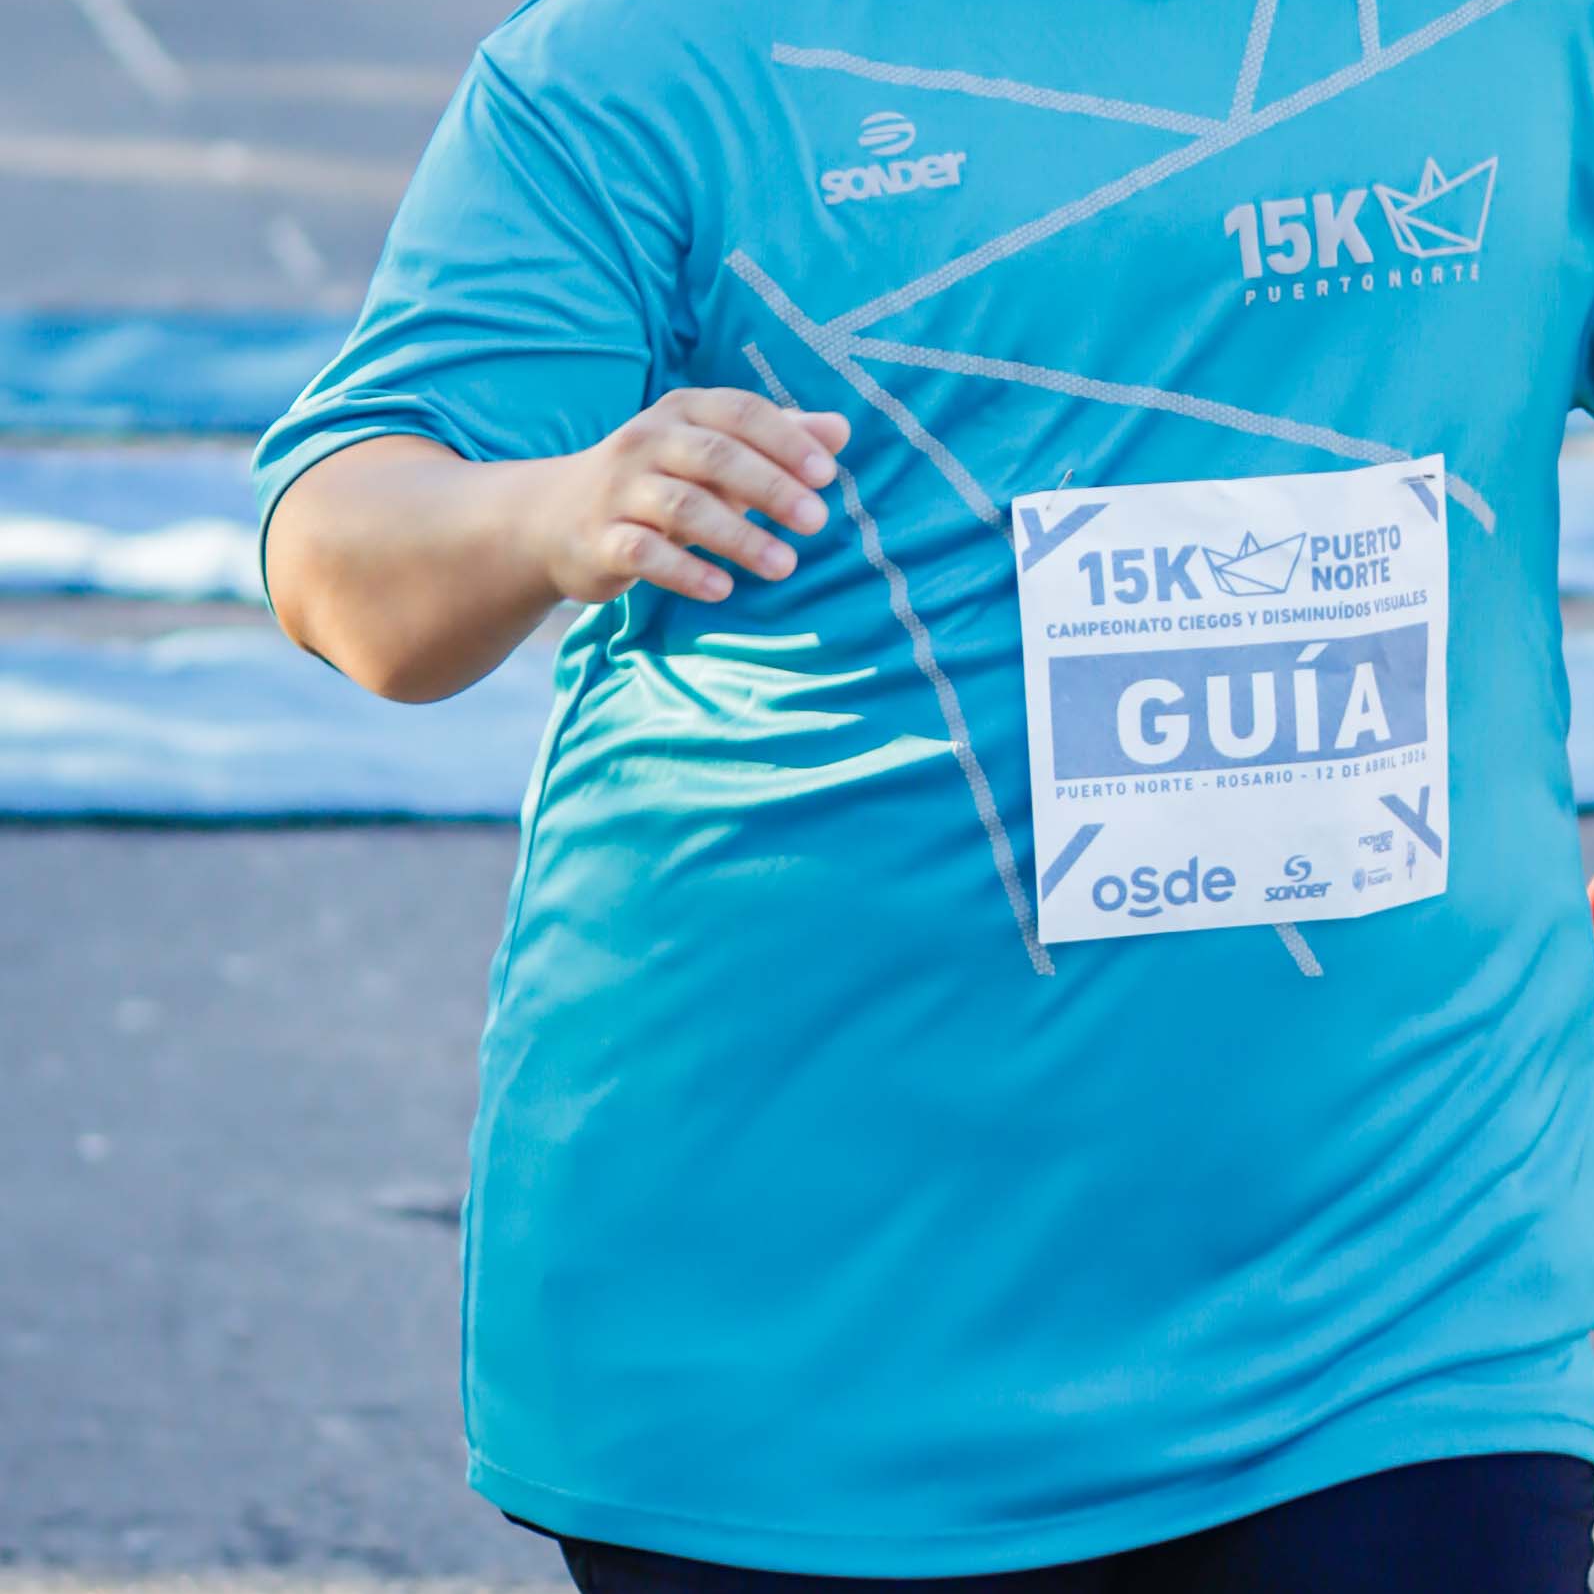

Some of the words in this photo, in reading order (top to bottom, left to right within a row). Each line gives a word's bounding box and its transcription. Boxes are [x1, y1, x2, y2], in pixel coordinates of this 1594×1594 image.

[1224, 189, 1374, 279] 15K
[1310, 525, 1402, 563] PUERTO
[1078, 545, 1202, 605] 15K
[1311, 557, 1391, 592] NORTE
[1047, 616, 1172, 639] CAMPEONATO
[1178, 611, 1243, 631] CIEGOS
[1248, 610, 1259, 627] Y
[1263, 601, 1371, 626] DISMINUÍDOS
[1374, 589, 1428, 616] VISUALES
[1116, 643, 1392, 765] GUÍA
[1056, 780, 1126, 800] PUERTO
[1135, 776, 1194, 794] NORTE
[1216, 769, 1293, 789] ROSARIO
[1316, 766, 1335, 781] 12
[1342, 761, 1361, 779] DE
[1365, 755, 1397, 774] ABRIL
[1092, 855, 1236, 913] osde
